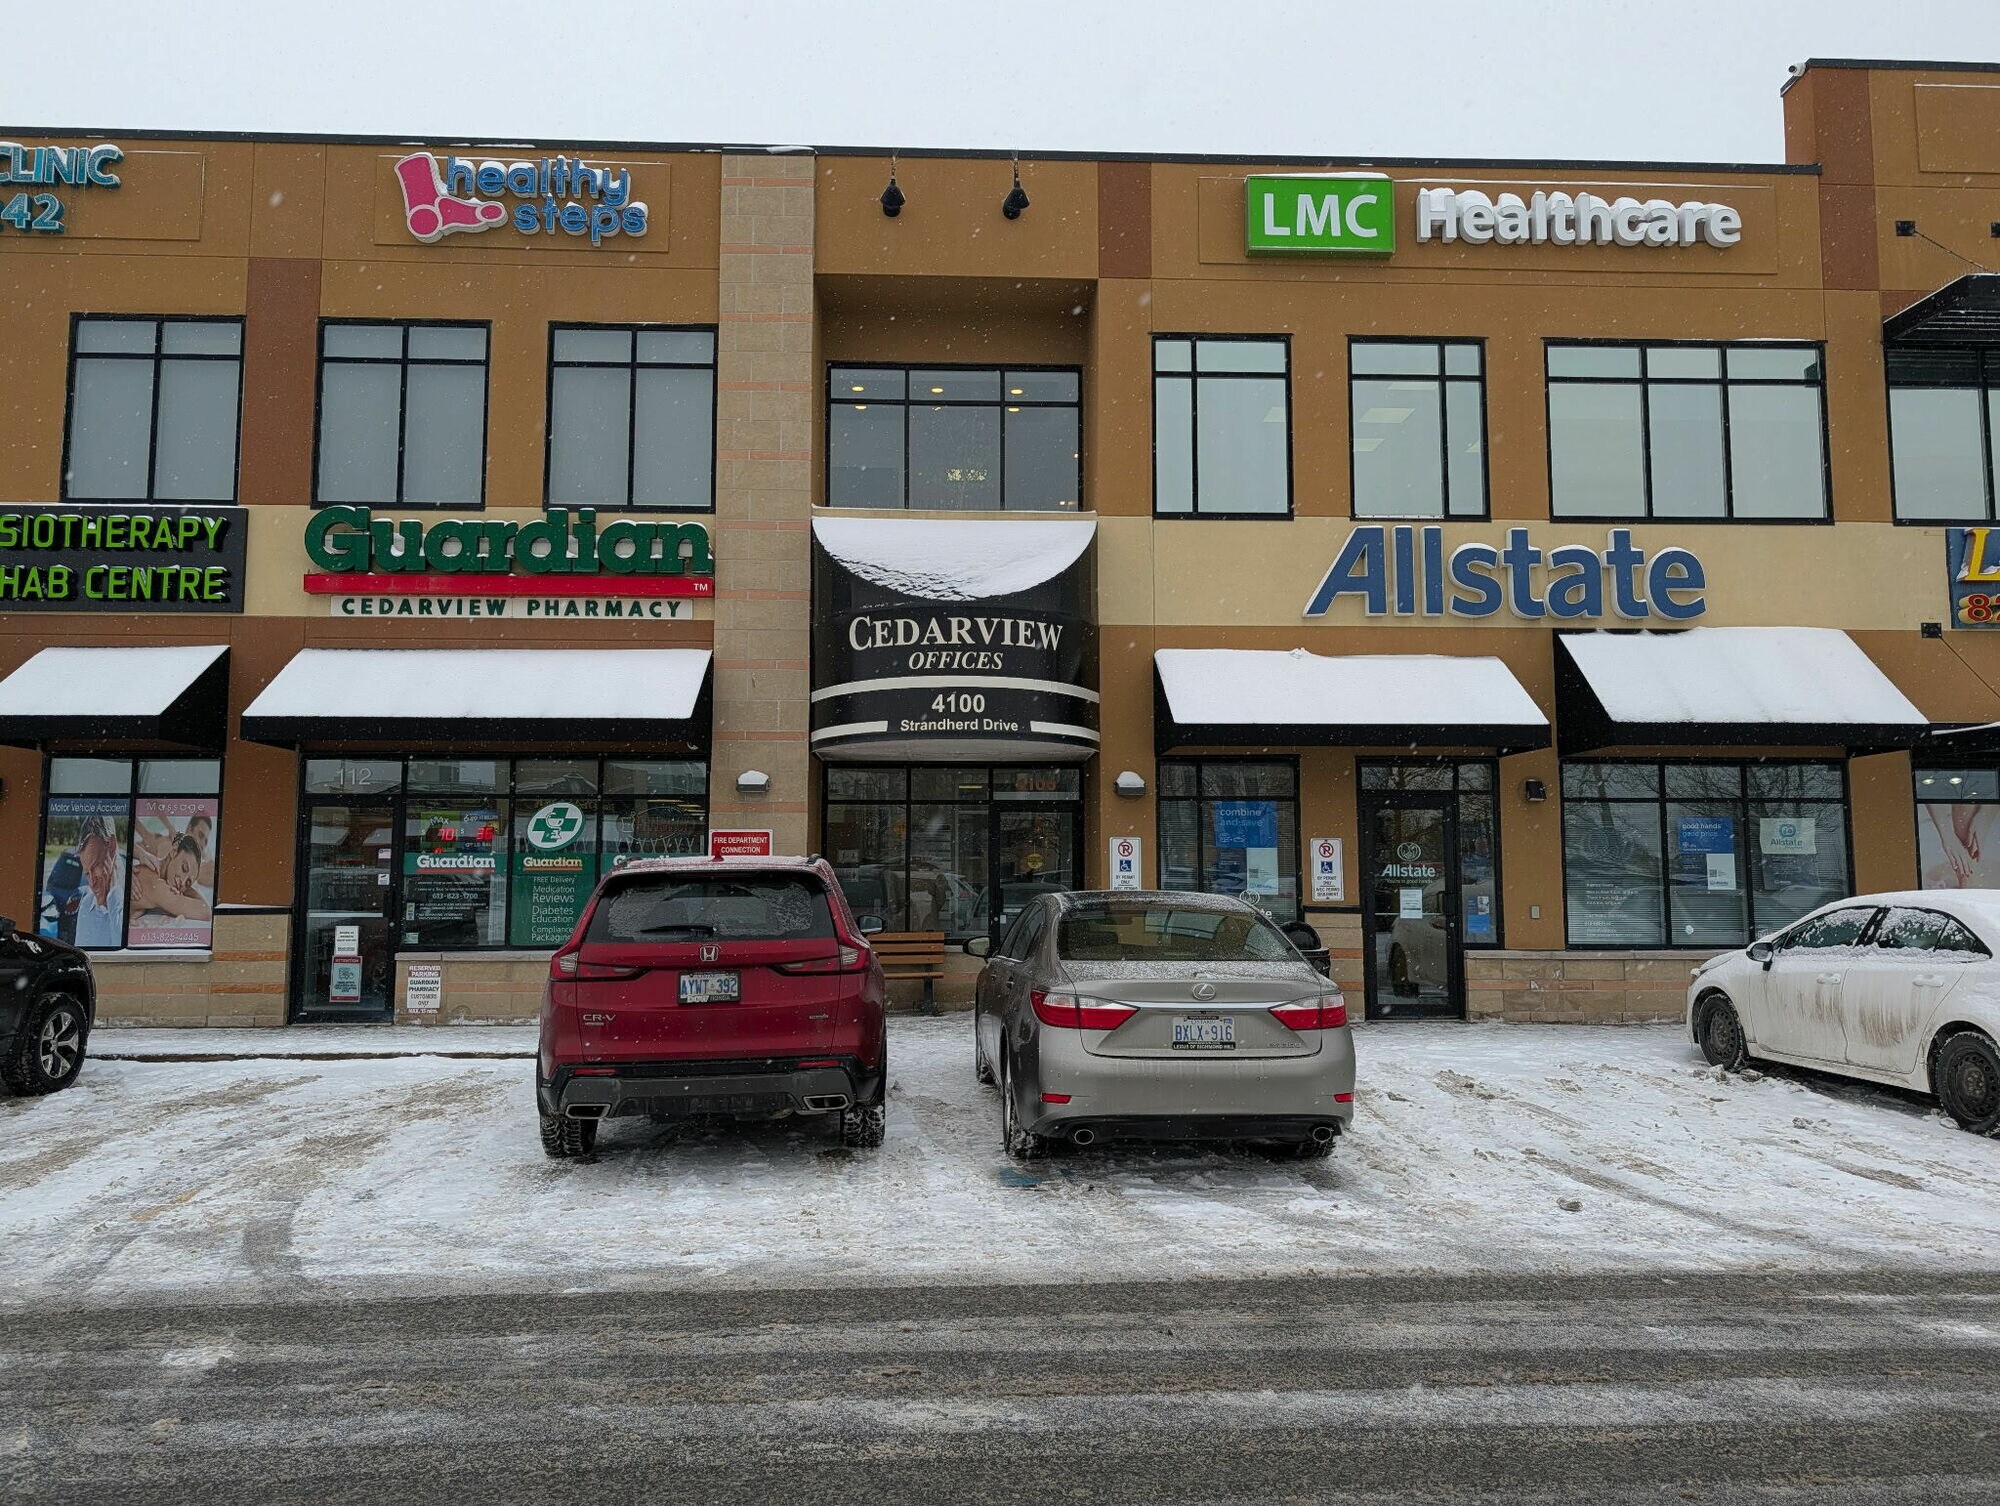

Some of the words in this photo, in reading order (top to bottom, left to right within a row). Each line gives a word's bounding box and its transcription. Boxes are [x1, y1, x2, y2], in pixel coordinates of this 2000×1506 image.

[447, 155, 632, 208] healthy
[514, 195, 648, 246] steps
[1263, 192, 1379, 239] LMC
[1416, 187, 1742, 248] Healthcare
[0, 514, 226, 550] SIOTHERAPY
[304, 505, 715, 574] Guardian
[1302, 525, 1708, 620] Allstate
[0, 565, 73, 600] HAB
[85, 565, 231, 601] CENTRE
[342, 597, 507, 617] CEDARVIEW
[527, 599, 681, 619] PHARMACY
[1958, 593, 2000, 624] 8
[849, 615, 1064, 652] CEDARVIEW
[908, 651, 1004, 671] OFFICES
[931, 693, 986, 714] 4100
[900, 718, 978, 733] Strandherd
[983, 718, 1019, 732] Drive
[336, 767, 372, 786] 112
[50, 802, 71, 813] Motor
[71, 802, 96, 813] Vehicle
[97, 802, 127, 813] Accident
[146, 802, 205, 813] Massage
[1220, 808, 1262, 817] combine
[714, 836, 729, 844] FIRE
[729, 836, 768, 845] DEPARTMENT
[720, 846, 761, 854] CONNECTION
[416, 854, 496, 868] Guardian
[522, 857, 583, 868] Guardian
[1381, 864, 1437, 877] Allstate
[533, 885, 575, 893] Medication
[532, 893, 575, 903] Reviews
[532, 905, 574, 915] Diabetes
[531, 915, 574, 923] Education
[531, 925, 573, 934] Compliance
[1211, 1025, 1233, 1041] 916
